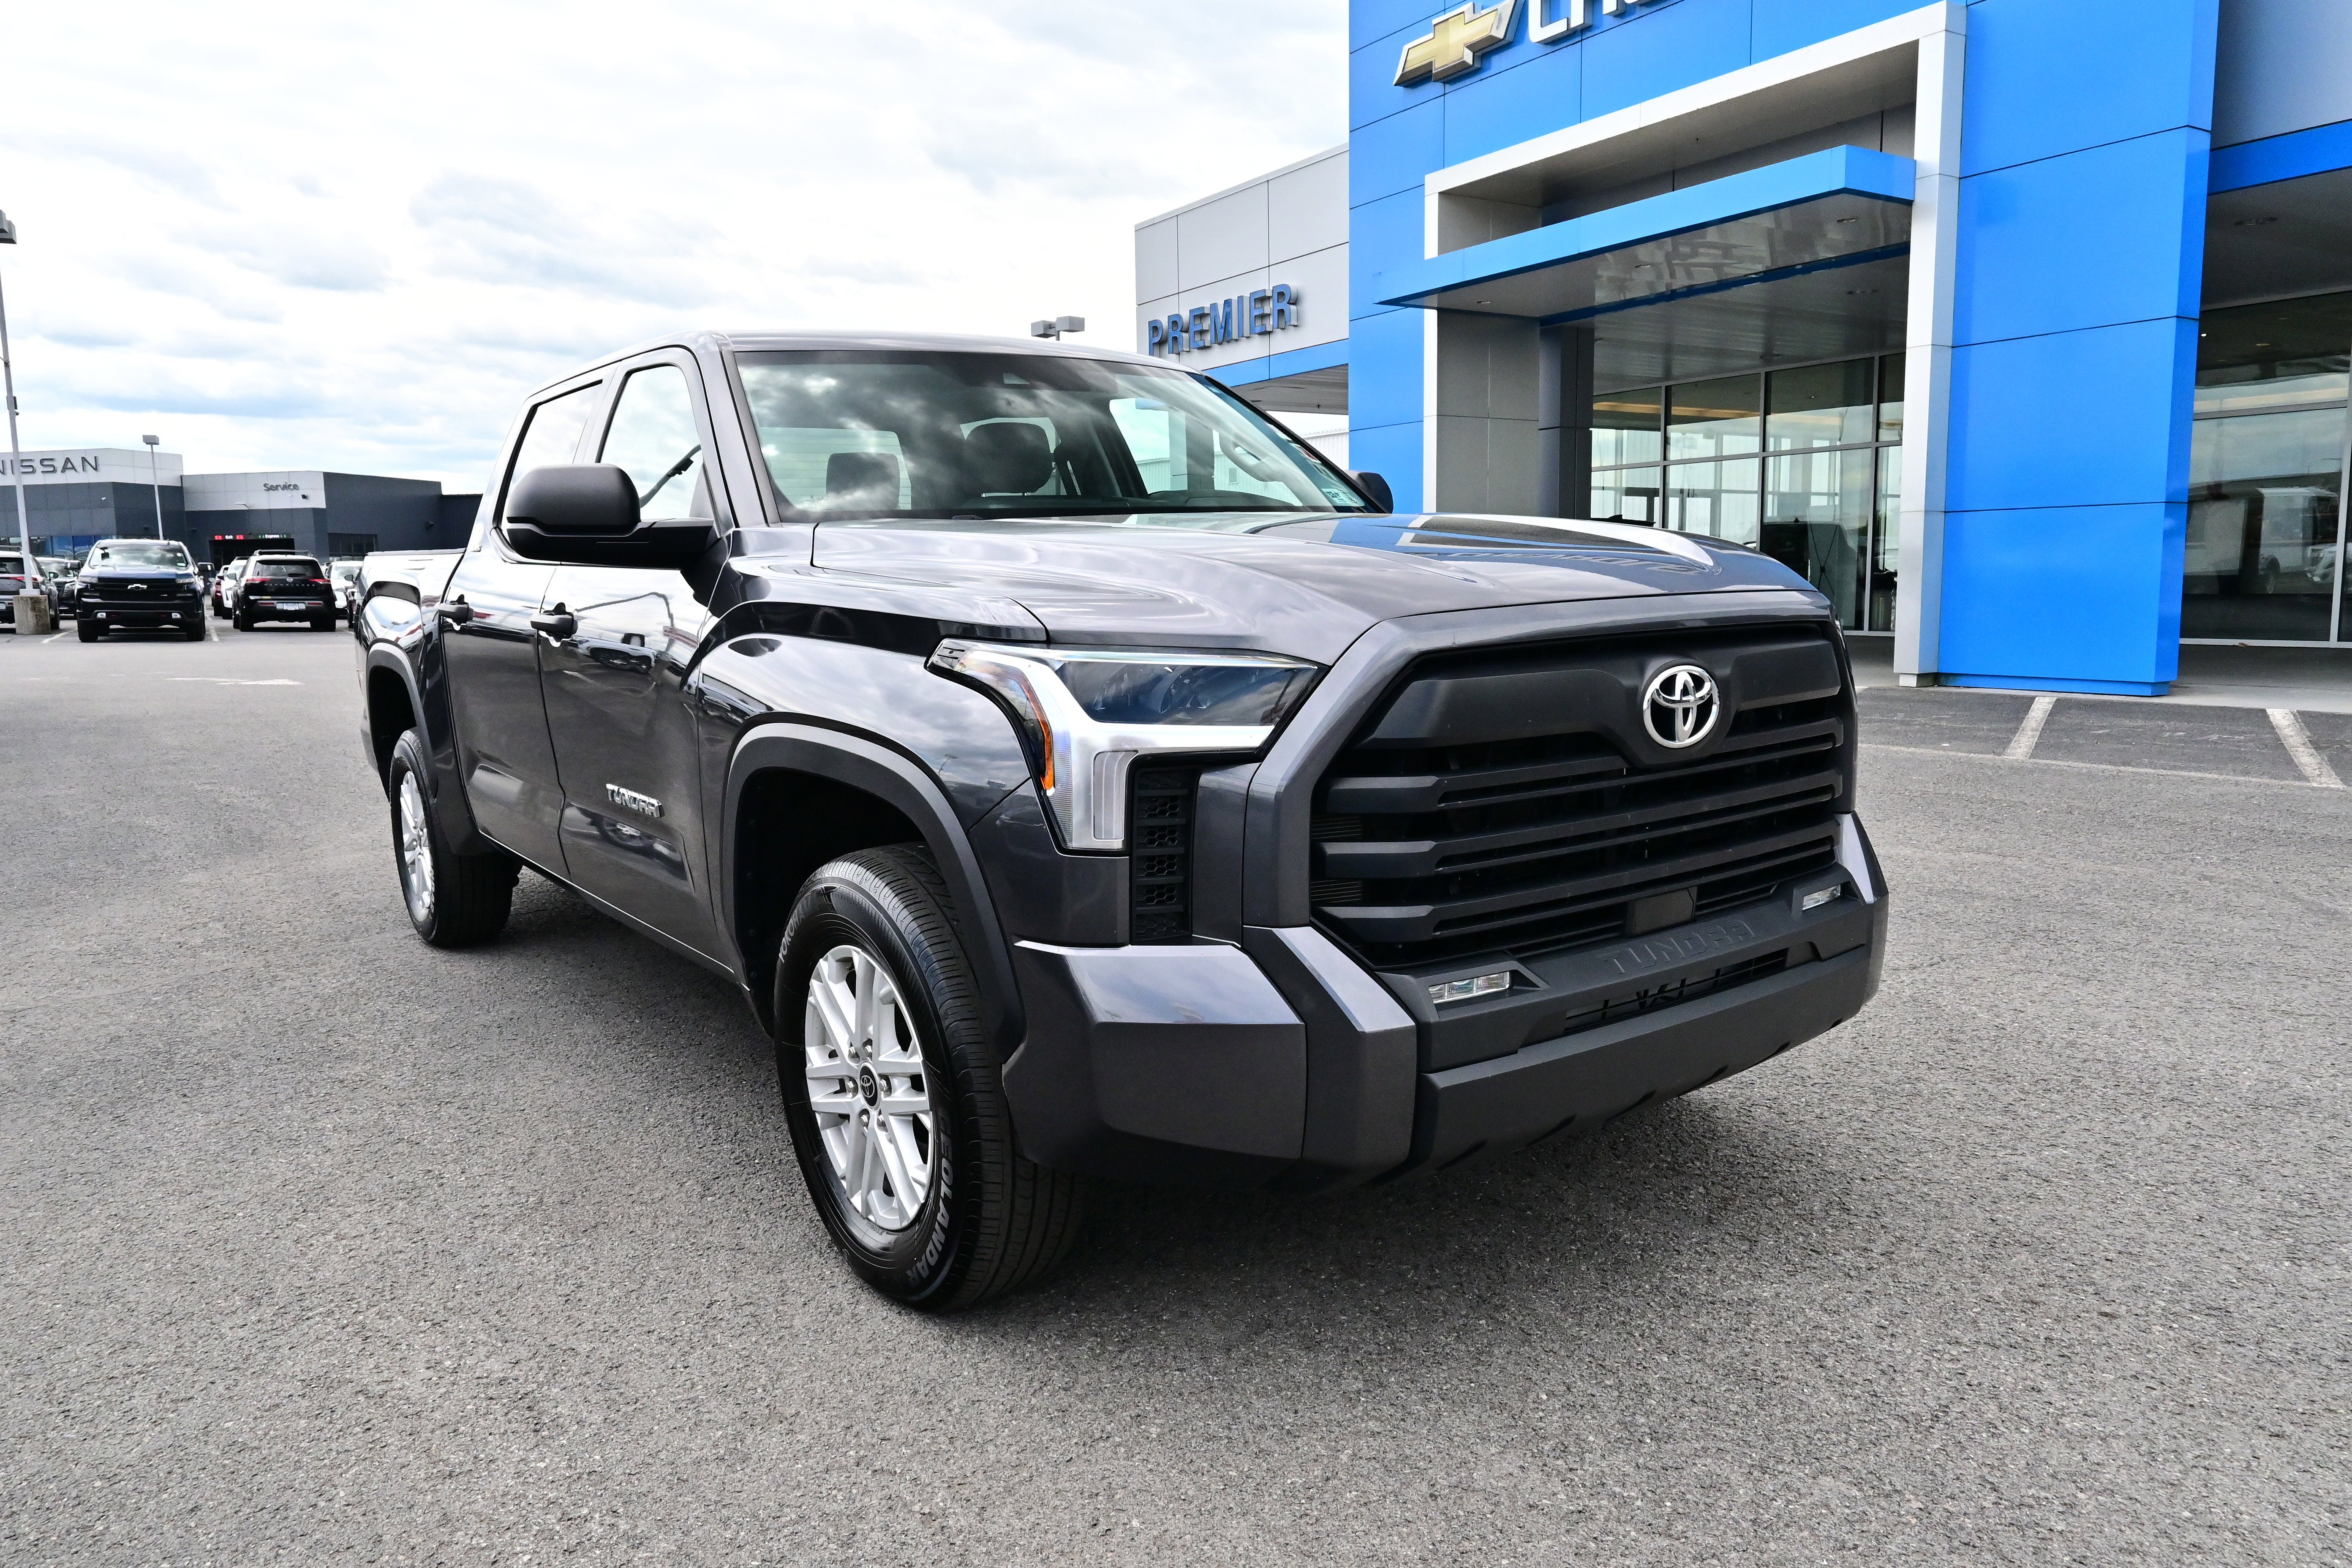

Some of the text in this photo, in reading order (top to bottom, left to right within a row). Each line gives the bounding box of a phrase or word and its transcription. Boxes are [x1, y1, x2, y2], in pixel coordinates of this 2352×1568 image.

[1148, 283, 1298, 356] PREMIER
[263, 482, 299, 492] Service
[606, 784, 664, 817] TUNDRA
[779, 900, 809, 964] YOKOH
[1596, 920, 1756, 975] TUNDRA
